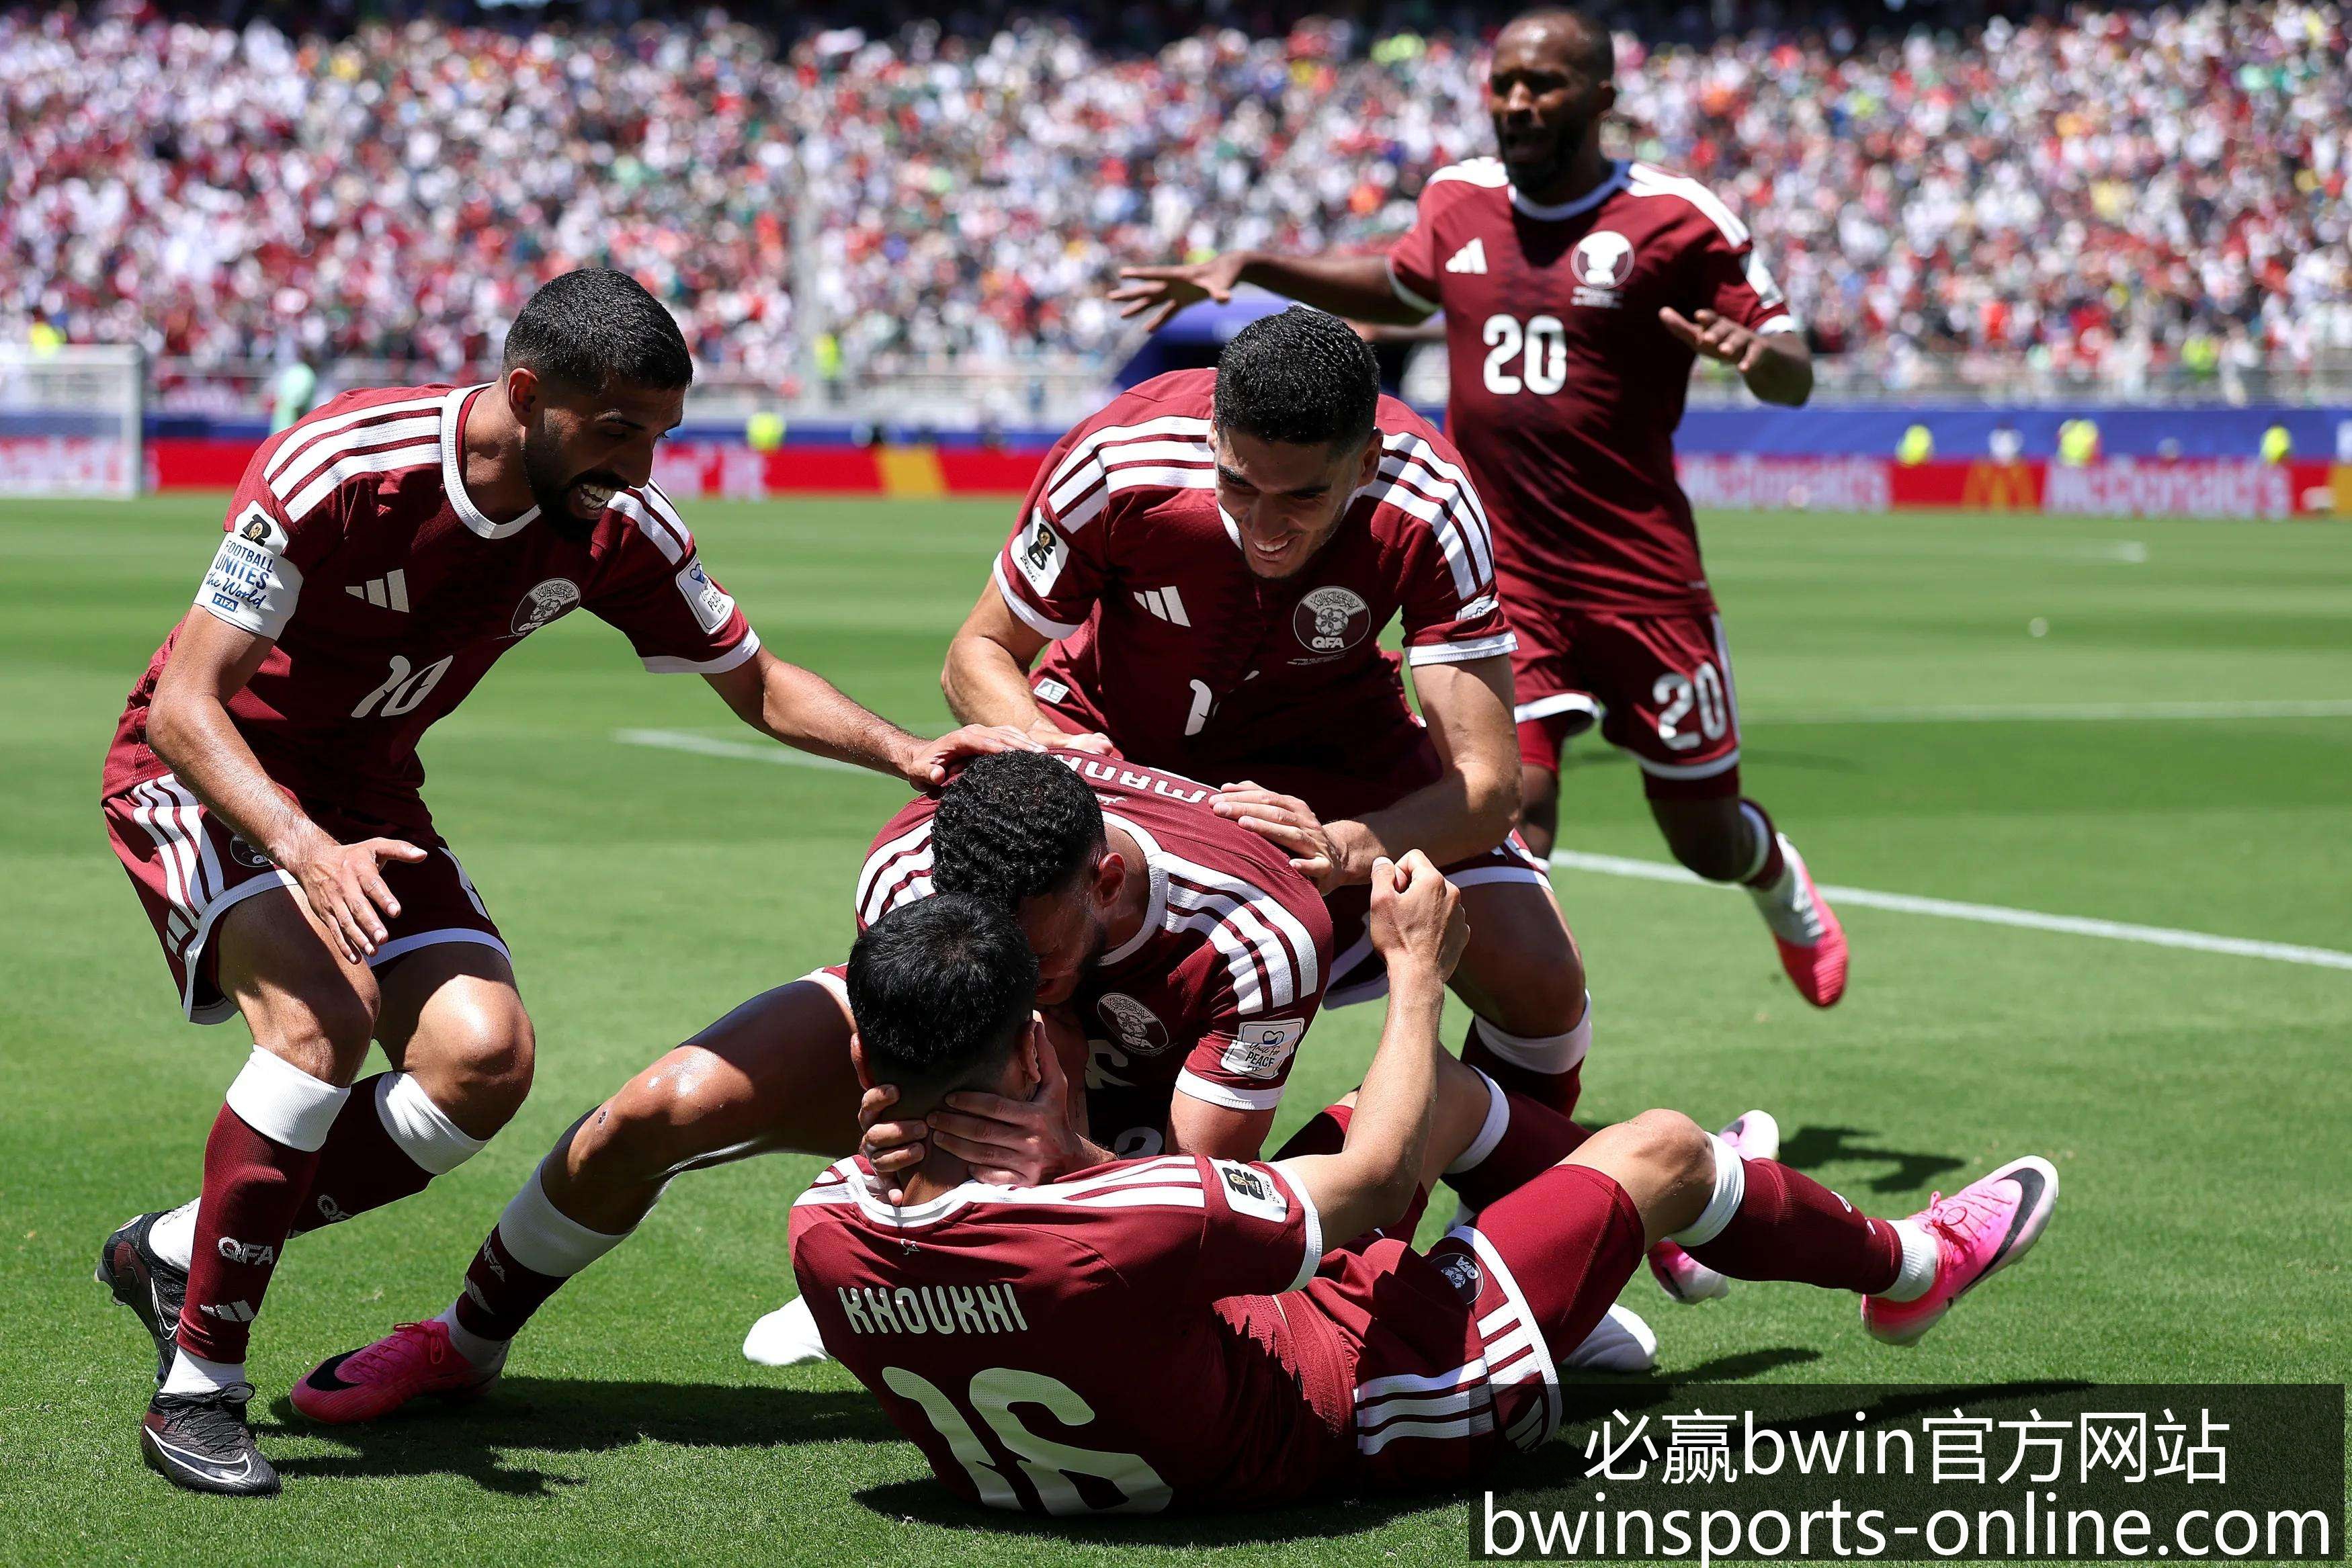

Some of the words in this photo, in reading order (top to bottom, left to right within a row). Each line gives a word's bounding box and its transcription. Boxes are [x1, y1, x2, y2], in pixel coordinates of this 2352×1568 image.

[1482, 314, 1567, 395] 20
[2044, 460, 2292, 520] McDonald's
[215, 554, 269, 590] UNITES
[226, 539, 274, 573] FOOTBALL
[206, 572, 221, 588] the
[222, 578, 267, 610] World
[212, 593, 238, 611] FIFA
[1312, 636, 1345, 649] QFA
[351, 654, 454, 718] 10
[1652, 662, 1726, 750] 20
[218, 1236, 274, 1265] QFA
[1456, 1256, 1480, 1280] QFA
[837, 1282, 1028, 1335] KHOUKHI
[882, 1366, 1173, 1516] 16
